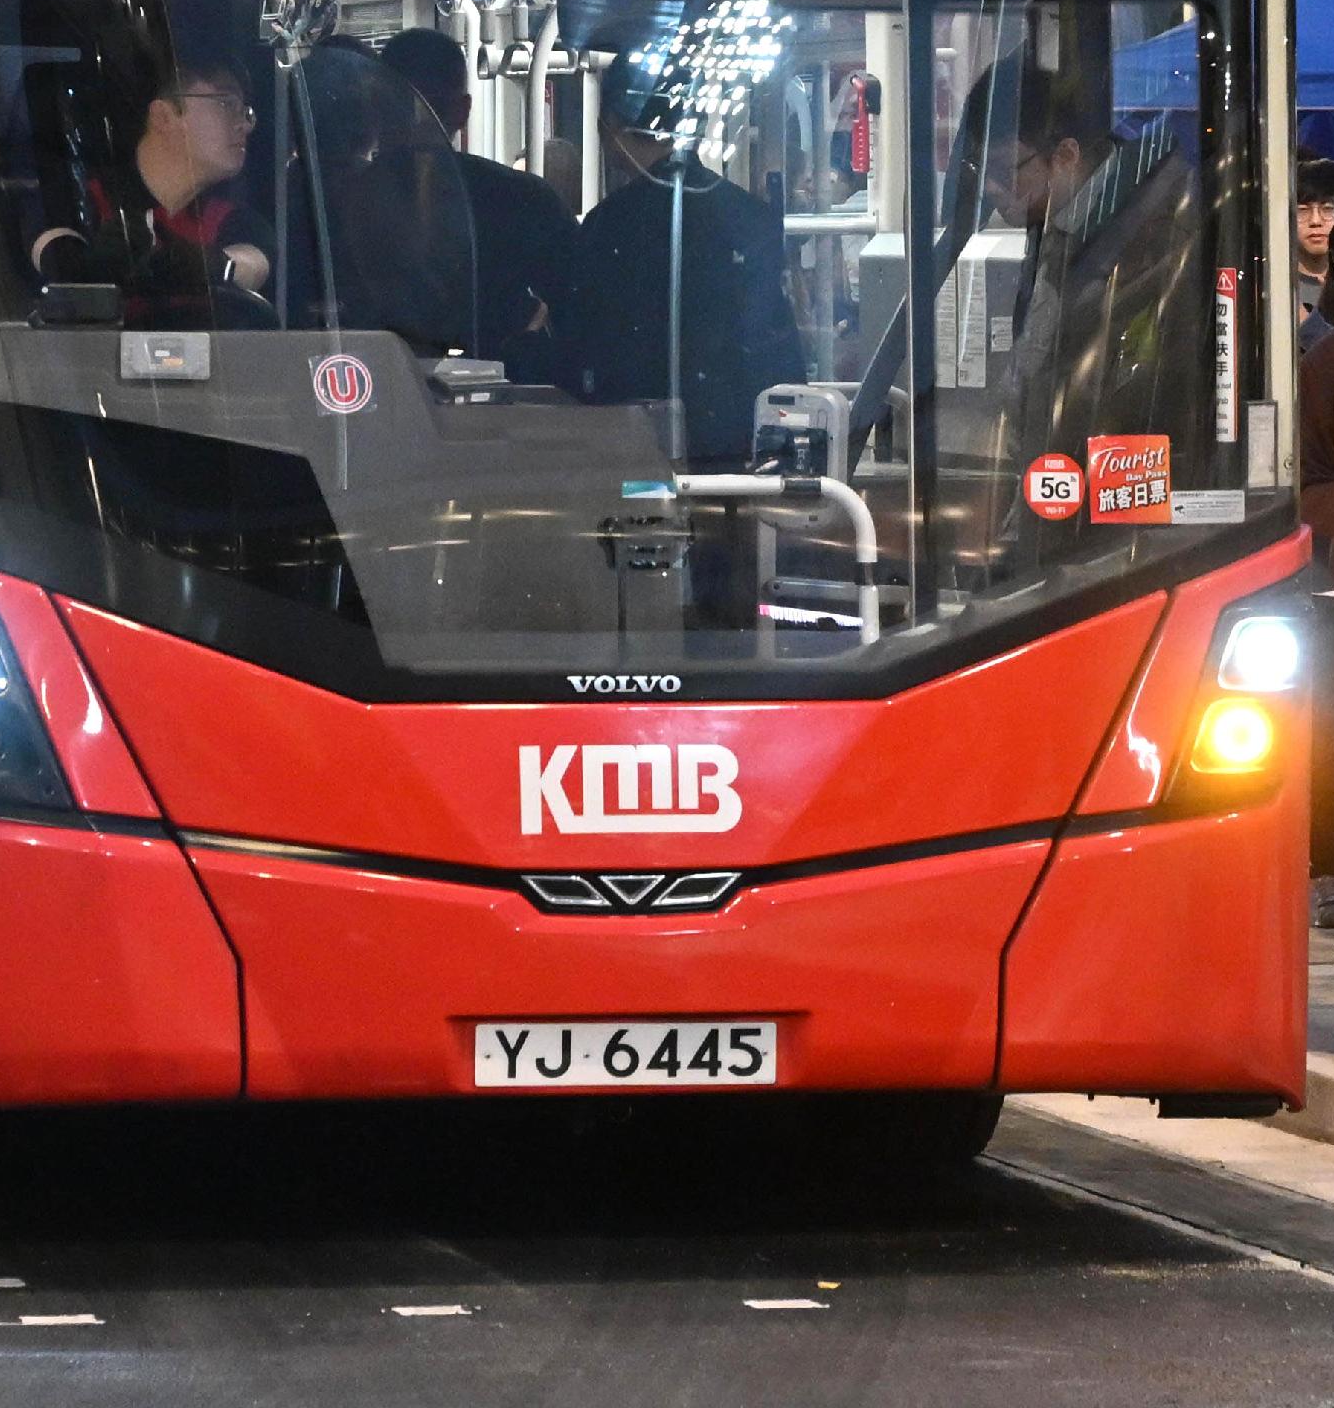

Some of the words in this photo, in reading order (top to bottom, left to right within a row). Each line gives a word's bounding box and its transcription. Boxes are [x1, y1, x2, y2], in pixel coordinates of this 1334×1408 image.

[1090, 446, 1165, 480] Tourist
[1125, 471, 1143, 482] Day
[1145, 469, 1167, 480] Pass
[1040, 477, 1071, 499] 5G
[1098, 479, 1167, 513] 旅客日票
[567, 674, 682, 693] VOLVO
[518, 743, 743, 835] KMB
[494, 1029, 572, 1079] YJ
[602, 1027, 763, 1078] 6445
